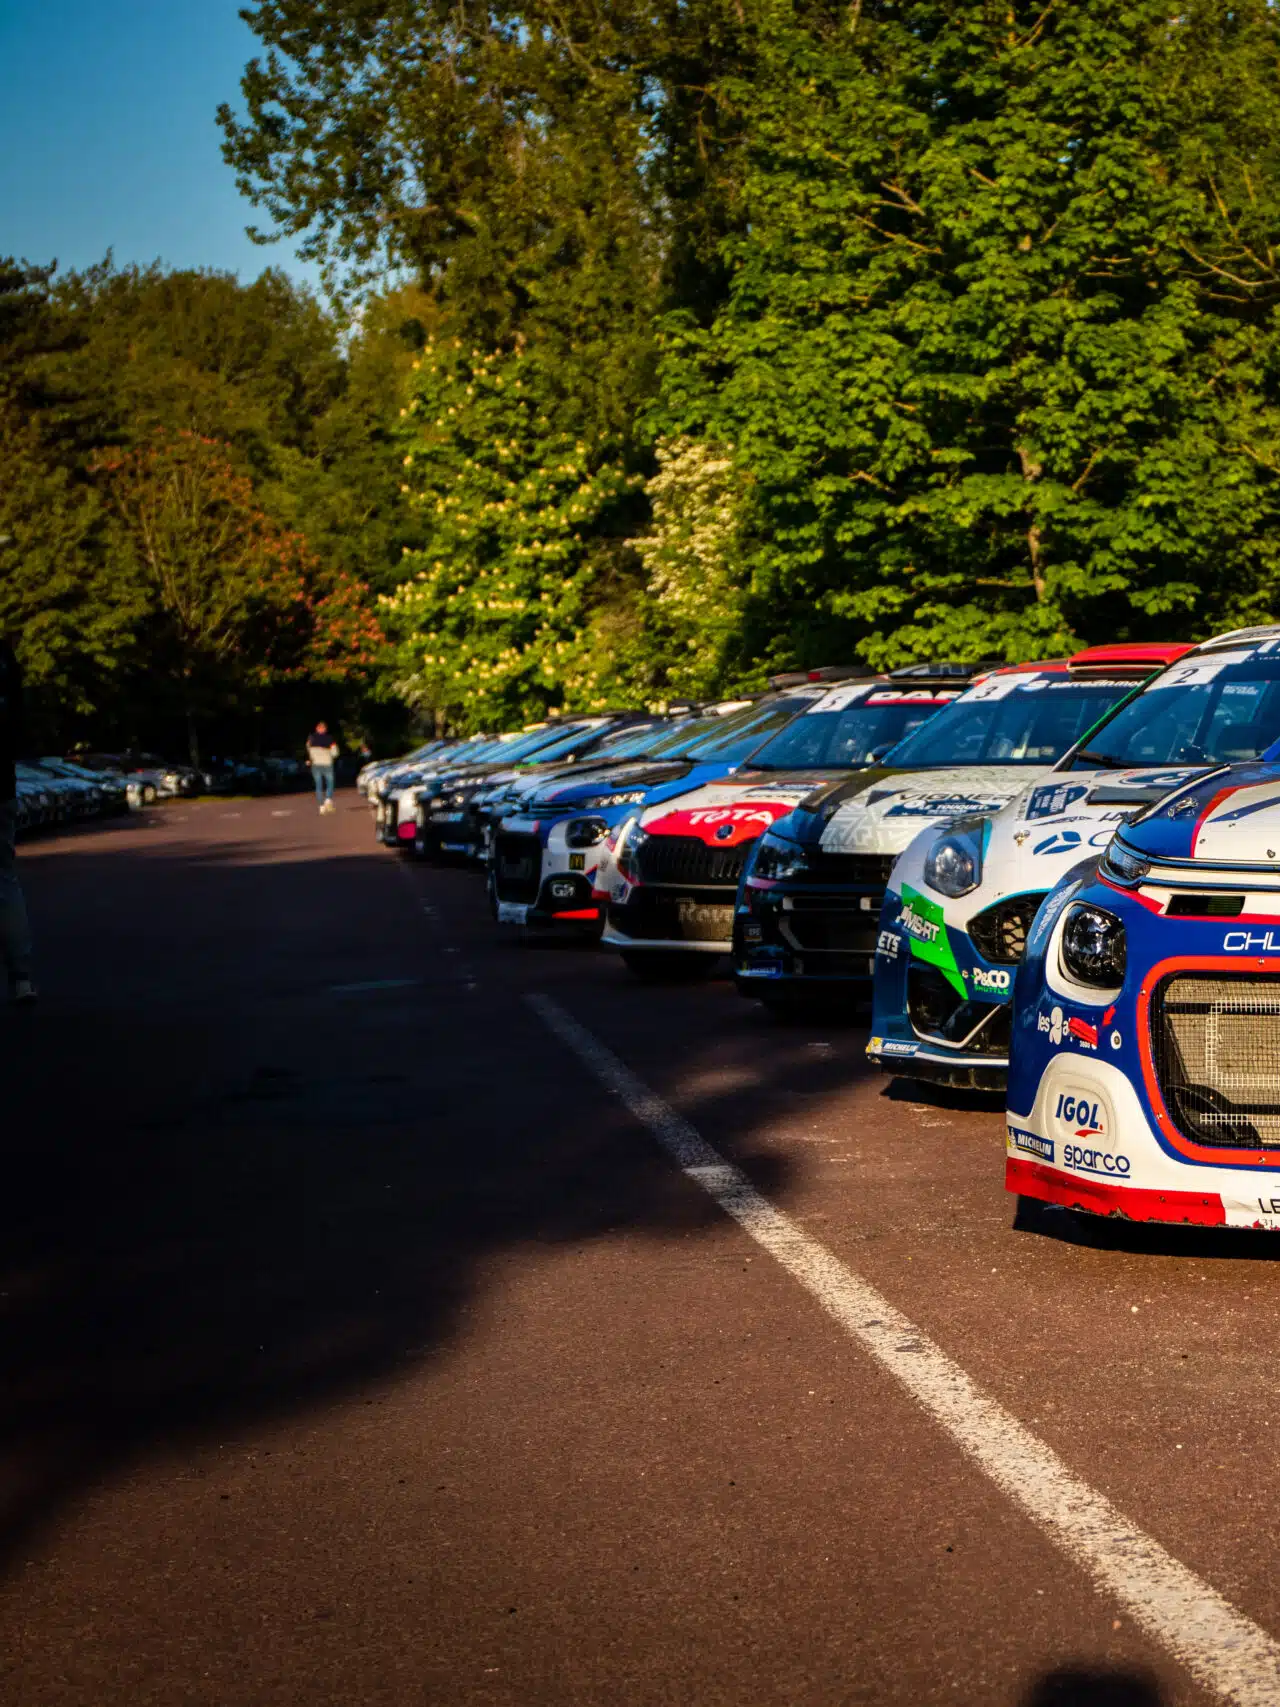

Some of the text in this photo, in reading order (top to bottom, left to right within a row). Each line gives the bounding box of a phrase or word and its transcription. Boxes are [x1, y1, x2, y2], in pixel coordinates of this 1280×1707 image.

[1171, 668, 1199, 684] 2
[975, 685, 999, 700] 3
[1038, 1011, 1050, 1032] les
[1017, 1133, 1053, 1156] MICHELIN
[1063, 1144, 1131, 1174] sparco
